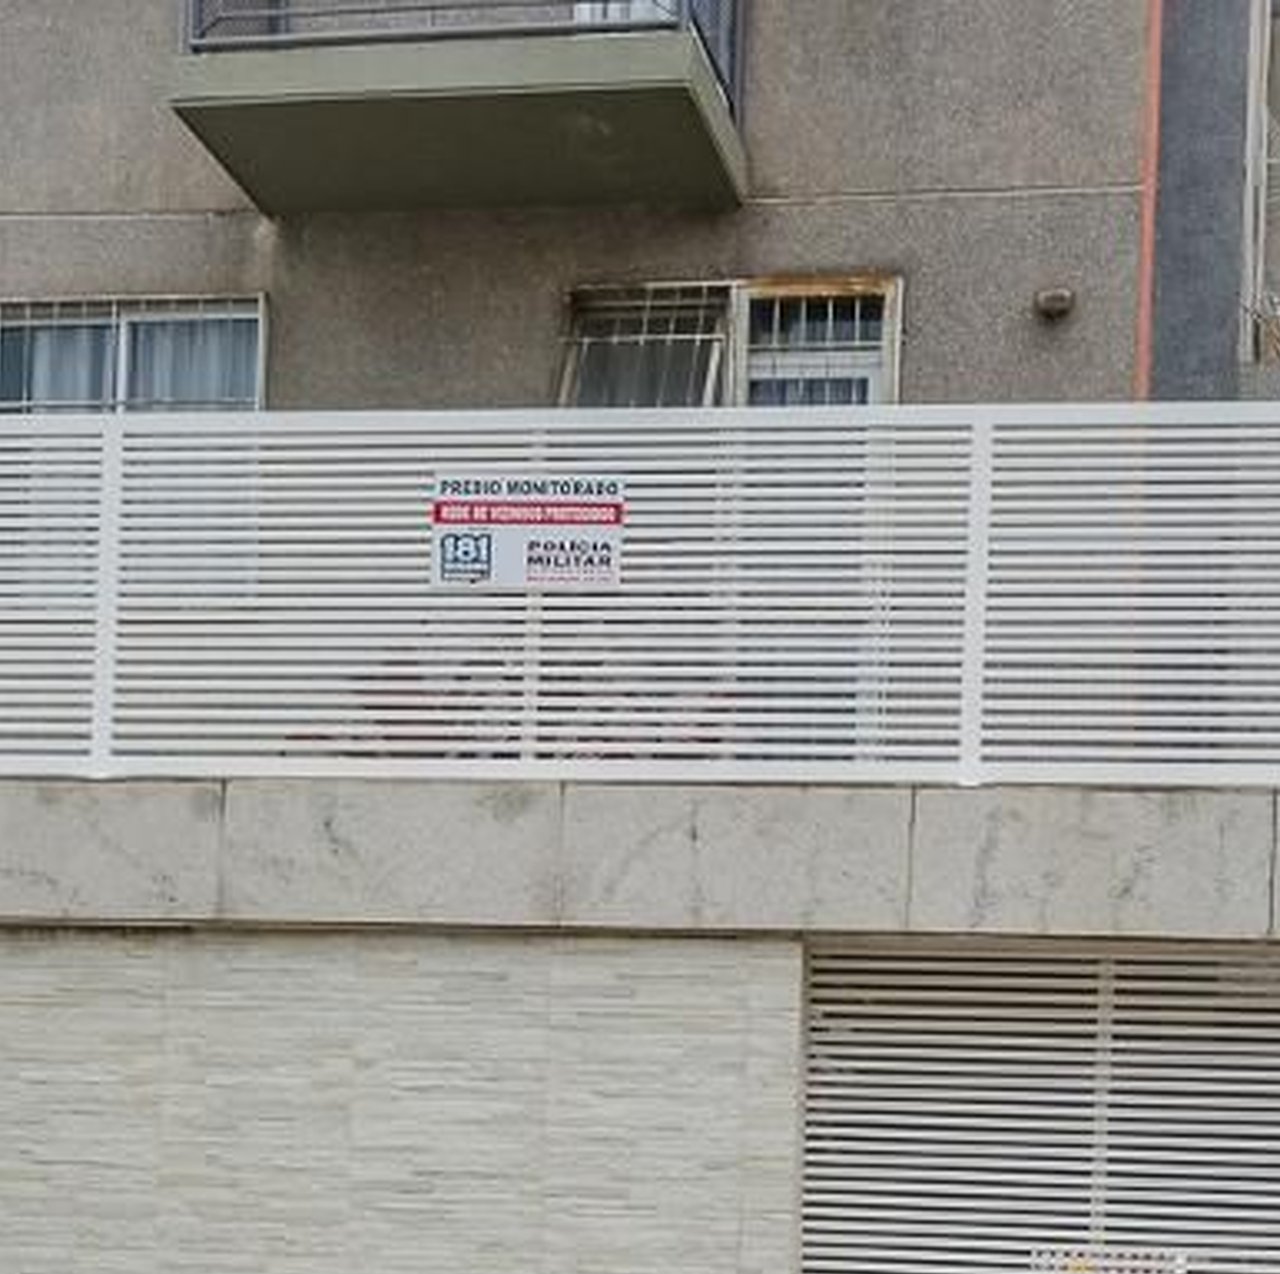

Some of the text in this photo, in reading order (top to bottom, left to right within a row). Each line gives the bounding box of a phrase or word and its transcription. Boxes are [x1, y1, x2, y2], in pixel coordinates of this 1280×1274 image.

[506, 480, 618, 495] MONITORADO
[442, 534, 490, 563] 181
[527, 556, 611, 568] MILITAR
